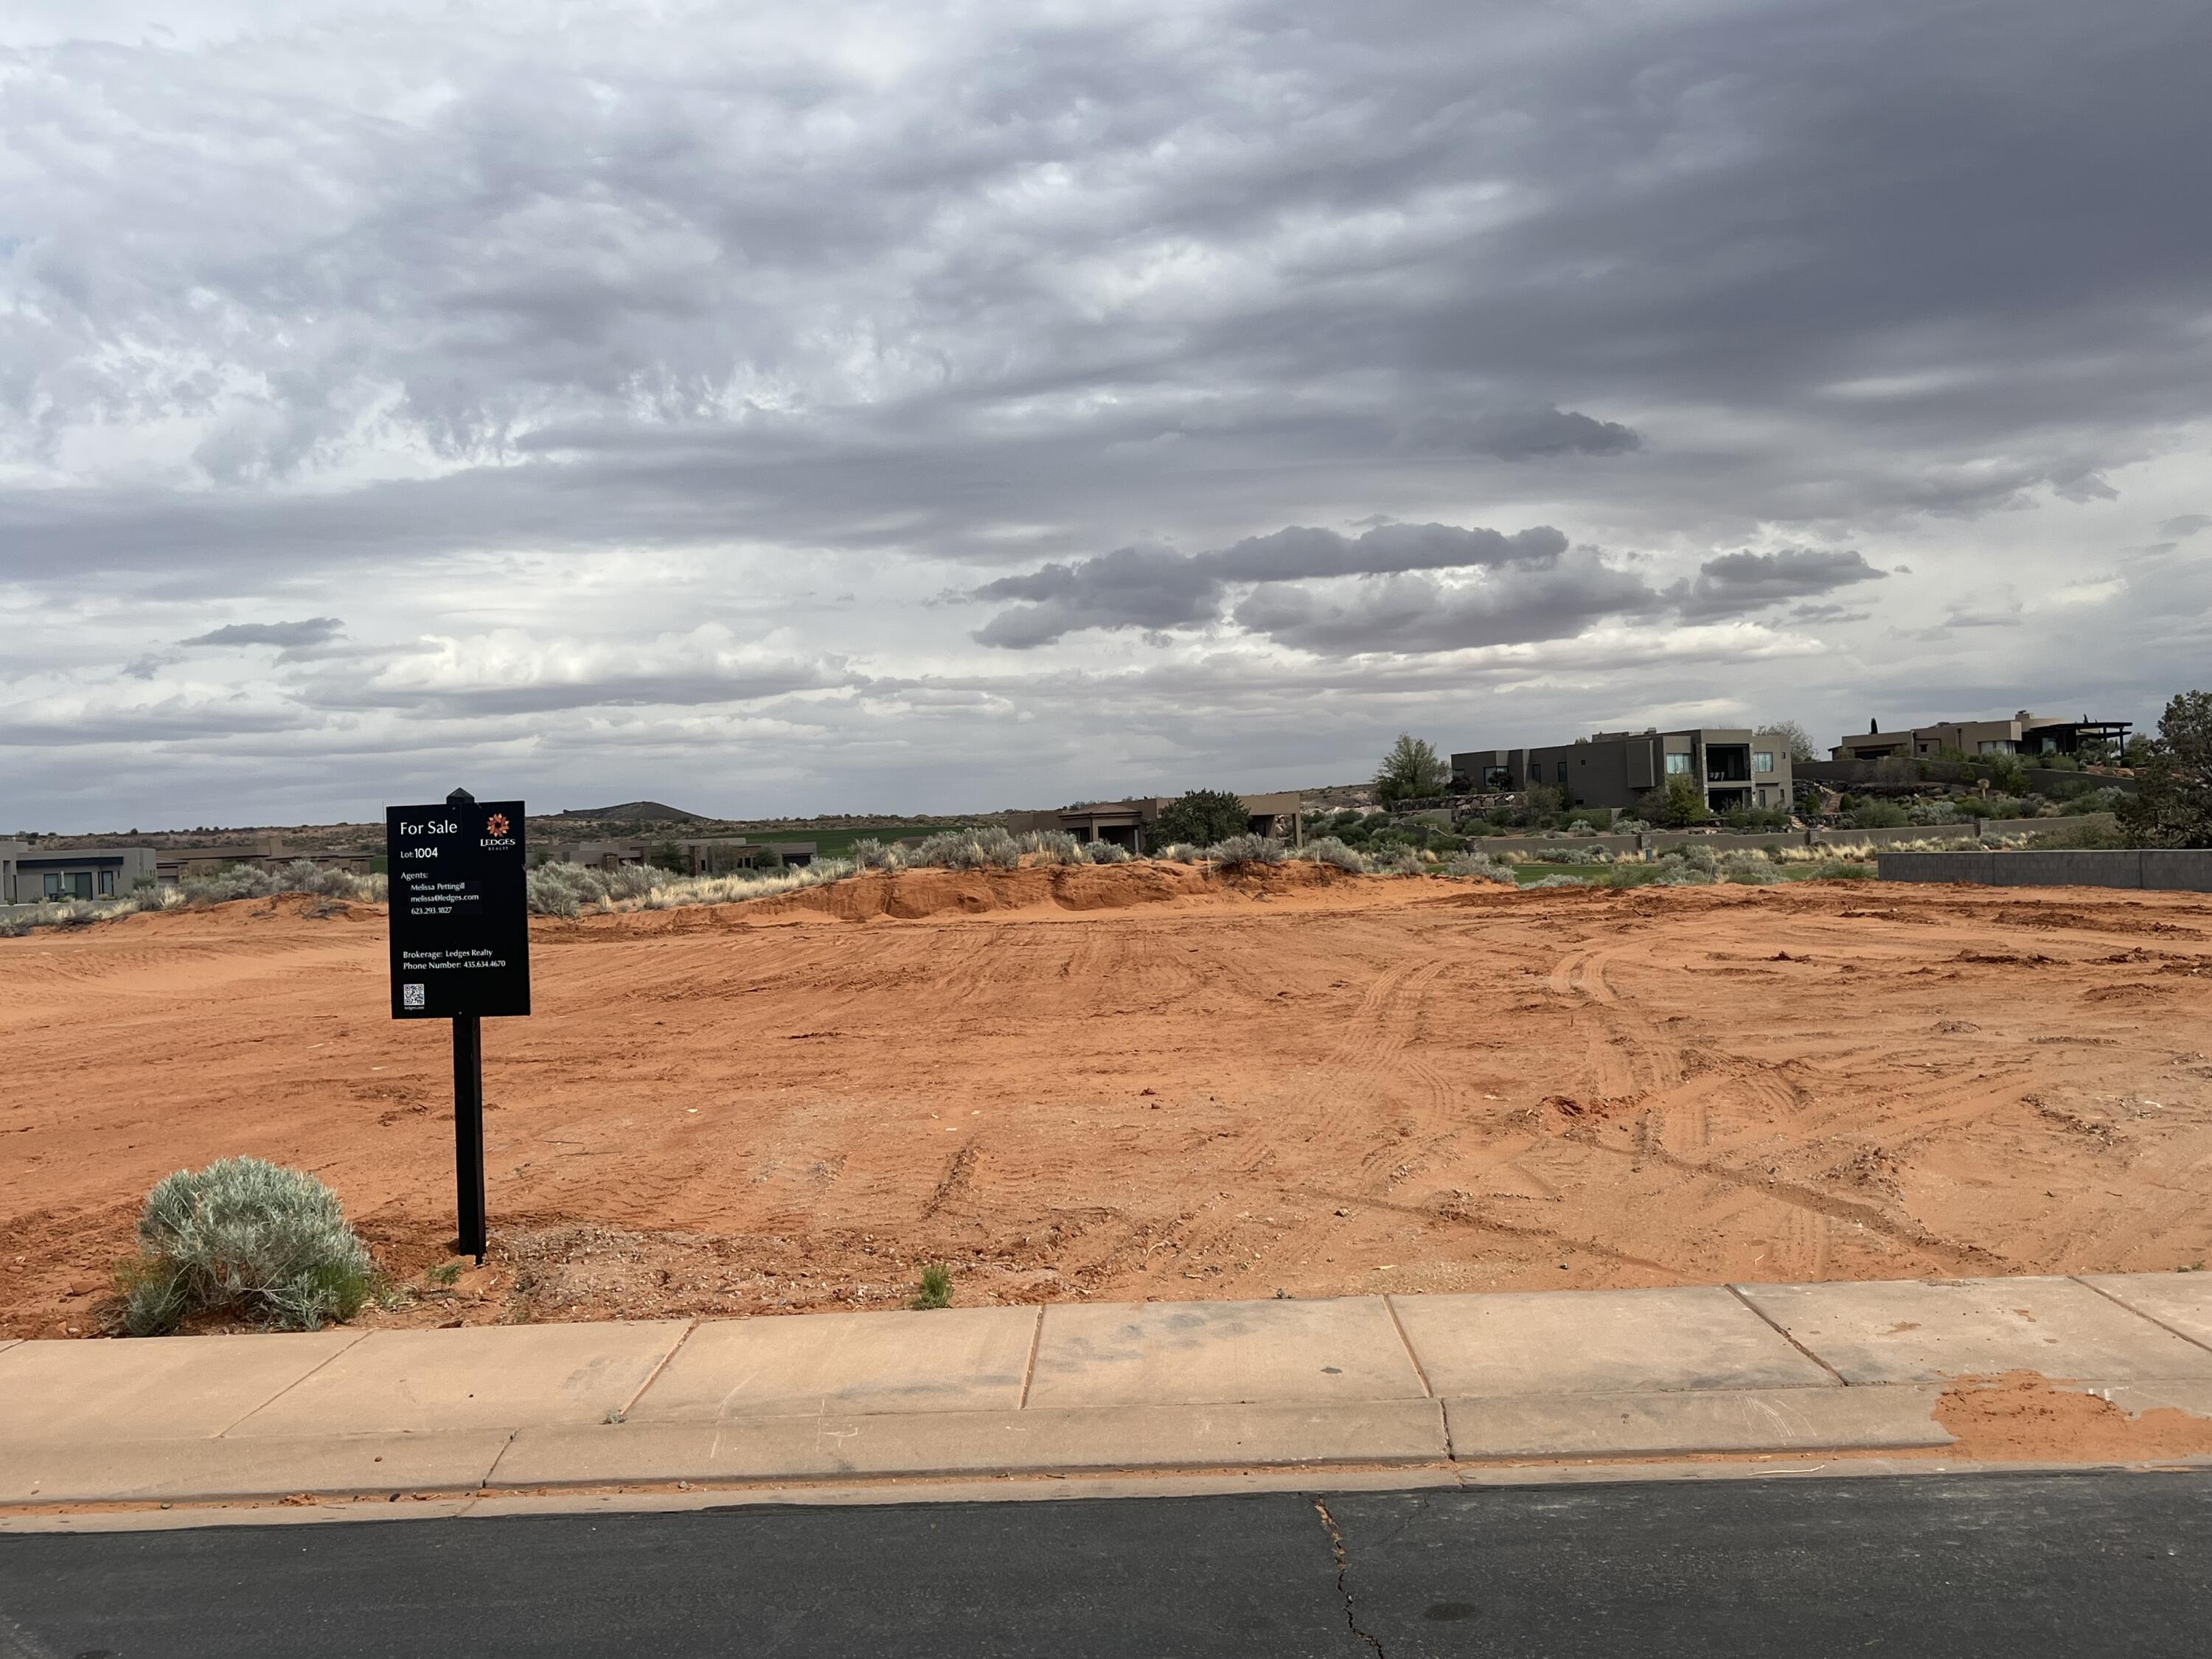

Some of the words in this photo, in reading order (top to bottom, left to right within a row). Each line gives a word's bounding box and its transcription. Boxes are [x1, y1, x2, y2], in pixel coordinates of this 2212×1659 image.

[400, 822, 424, 835] For
[428, 820, 458, 834] Sale
[480, 838, 515, 846] LEDGES
[414, 847, 438, 858] 1004
[400, 872, 428, 881] Agents:
[437, 883, 465, 891] Pettingill
[411, 894, 479, 902] melissa@ledges.com
[411, 906, 453, 914] 623.293.1827
[403, 951, 442, 959] Brokerage:
[445, 950, 470, 959] Ledges
[471, 949, 493, 957] Realty
[428, 961, 461, 969] Number:
